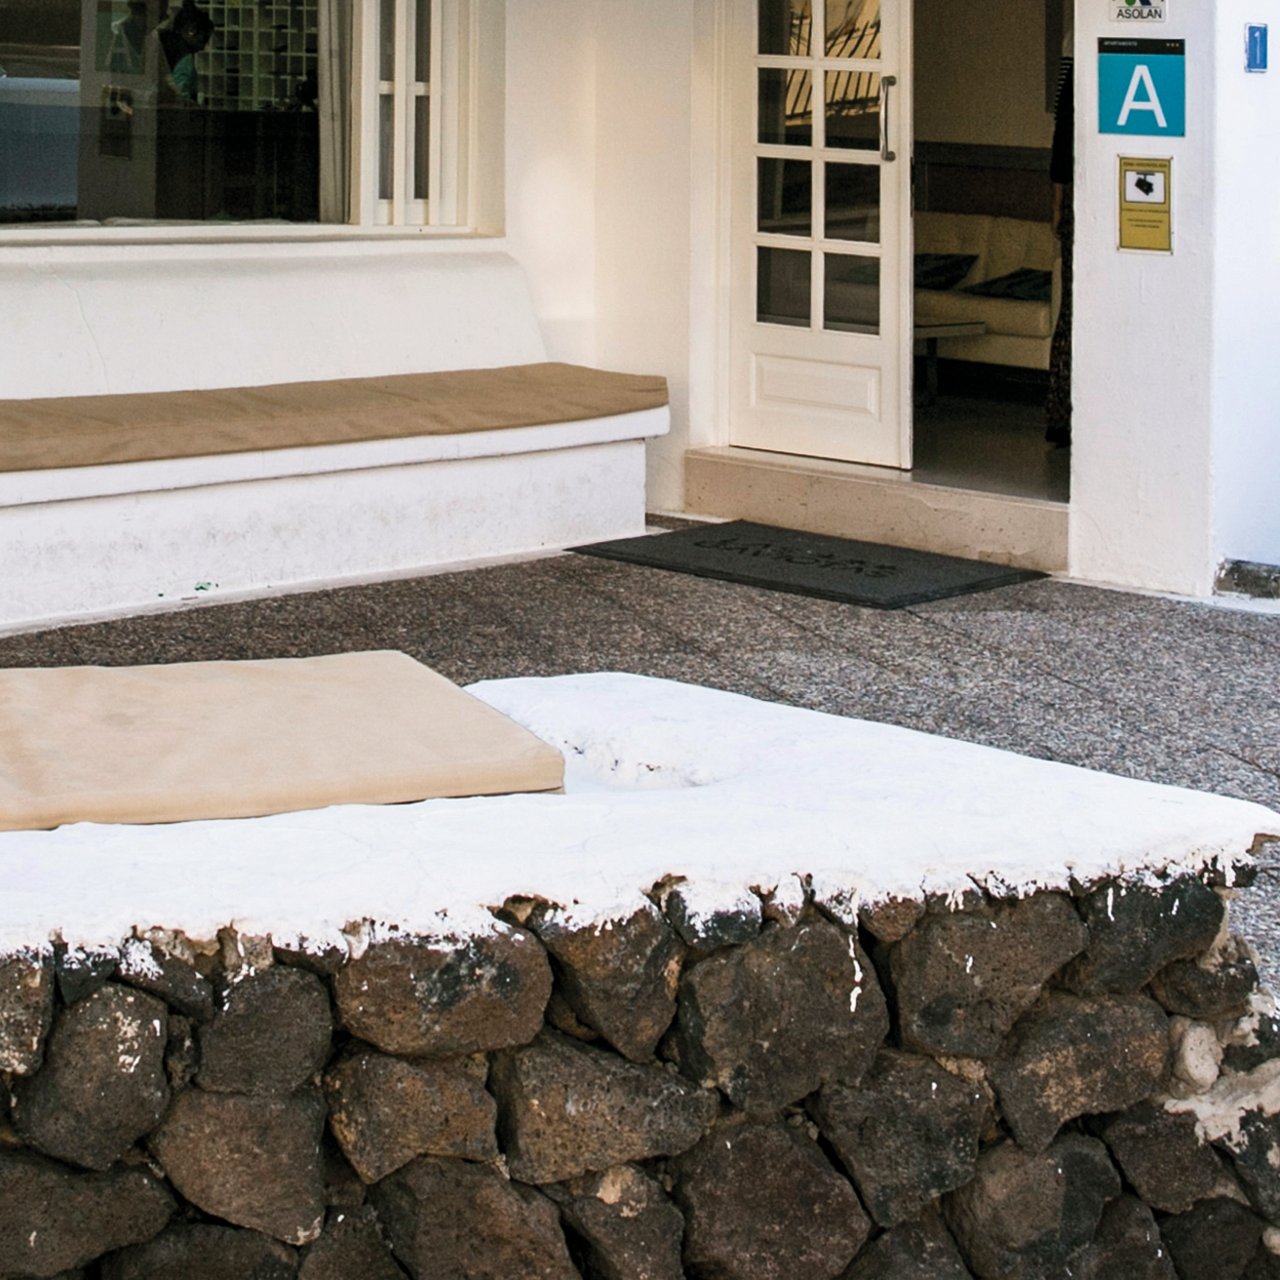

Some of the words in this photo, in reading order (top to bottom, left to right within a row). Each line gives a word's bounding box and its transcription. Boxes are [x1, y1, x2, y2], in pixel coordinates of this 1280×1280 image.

[1116, 8, 1162, 20] ASOLAN
[1253, 29, 1262, 65] 1
[1116, 64, 1168, 128] A
